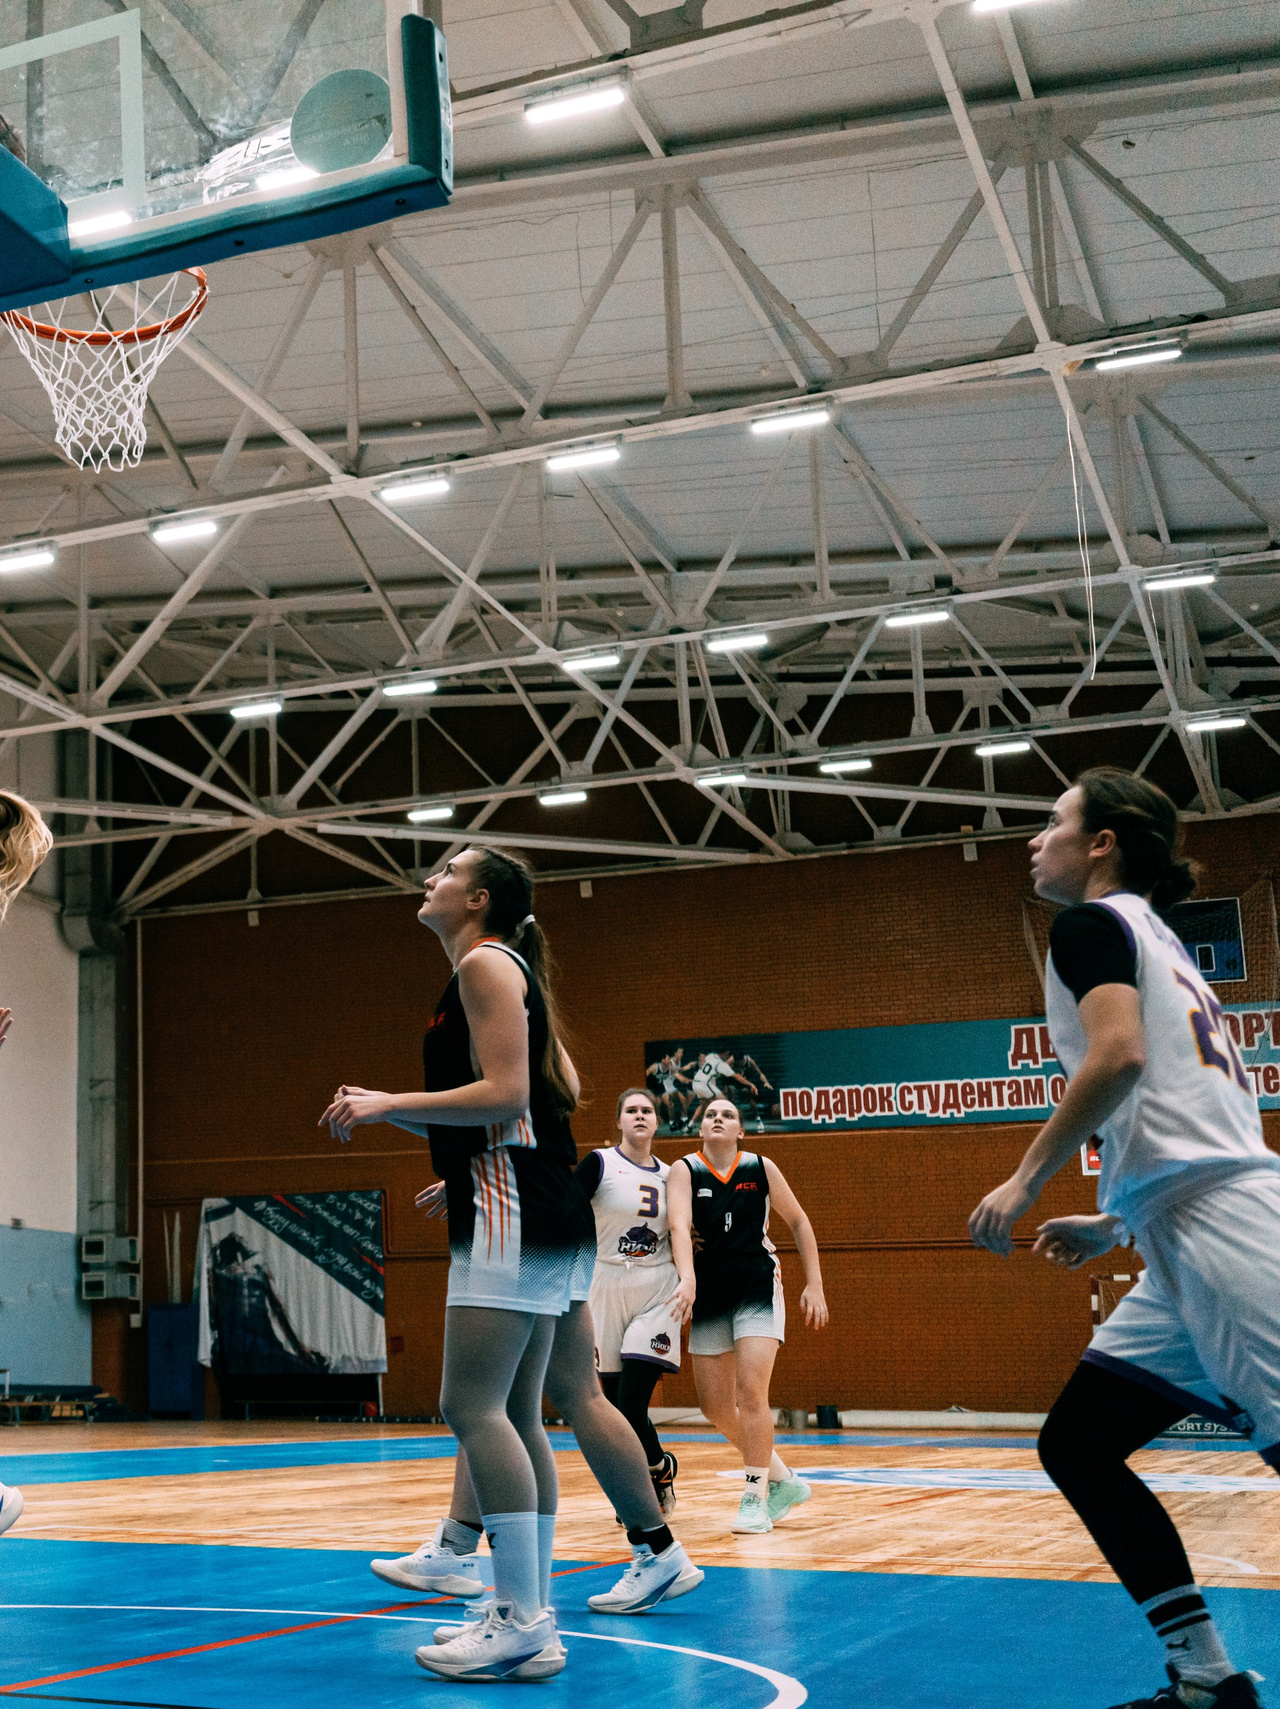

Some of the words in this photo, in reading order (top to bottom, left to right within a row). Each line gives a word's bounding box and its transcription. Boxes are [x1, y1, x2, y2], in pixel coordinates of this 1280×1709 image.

[781, 1084, 896, 1122] подарок
[898, 1076, 1046, 1116] студентам
[635, 1183, 661, 1219] 3
[723, 1211, 733, 1233] 9
